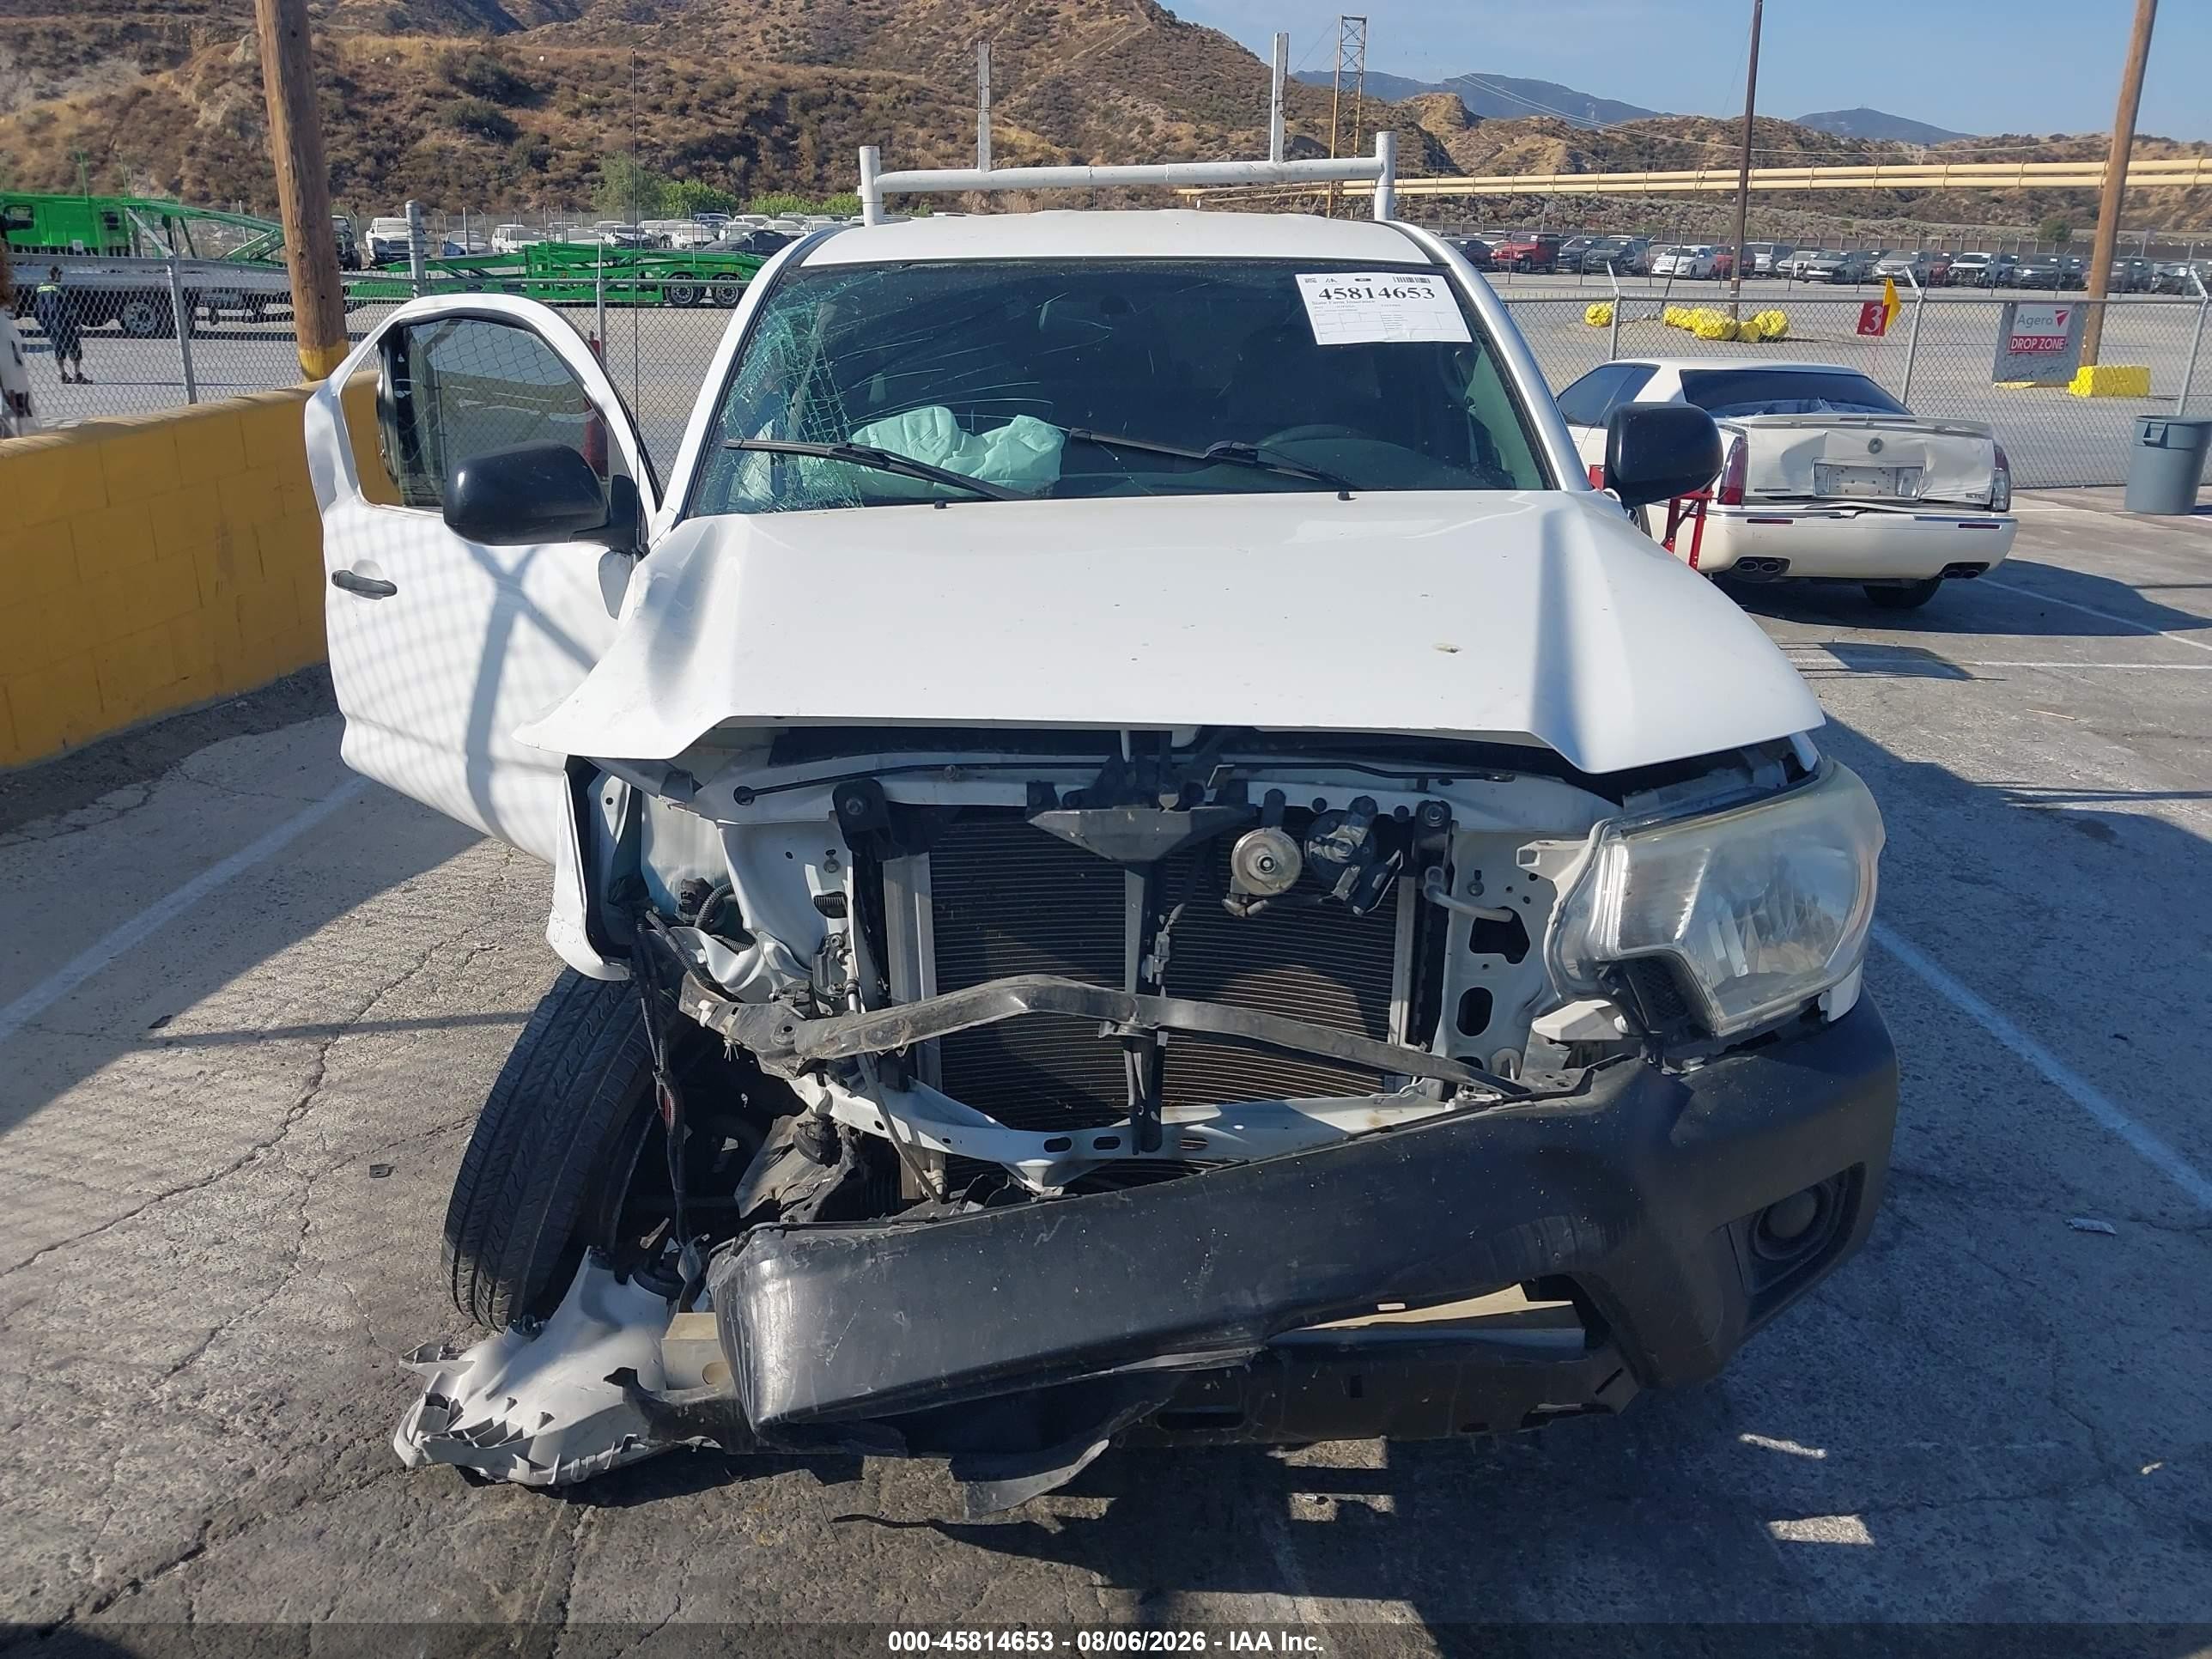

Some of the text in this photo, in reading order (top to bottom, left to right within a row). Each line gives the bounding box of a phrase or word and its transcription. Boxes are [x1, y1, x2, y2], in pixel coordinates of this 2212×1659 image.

[1318, 287, 1436, 300] 45814653
[1864, 305, 1884, 333] 3
[2017, 314, 2053, 328] Agero
[2010, 337, 2064, 349] DROP ZONE
